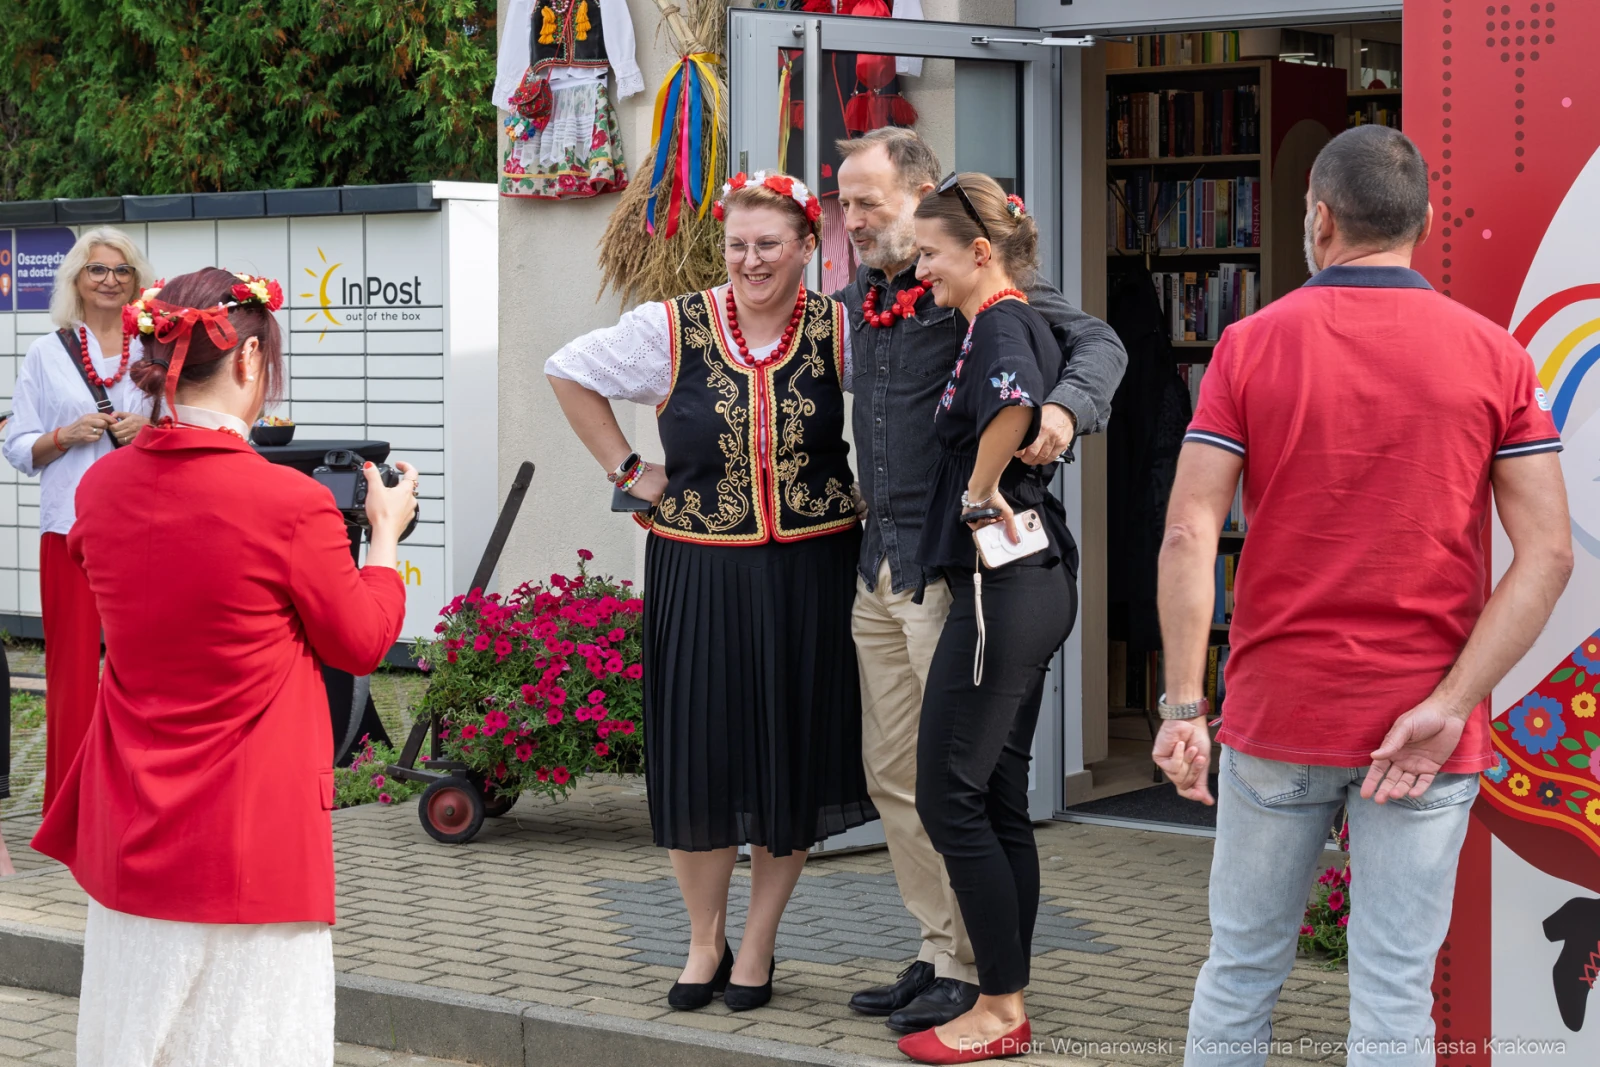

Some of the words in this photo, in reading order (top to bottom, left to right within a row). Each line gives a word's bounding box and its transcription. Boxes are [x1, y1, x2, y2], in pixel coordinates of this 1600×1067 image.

[17, 269, 28, 277] na
[342, 276, 421, 305] InPost
[345, 313, 362, 321] out
[367, 312, 377, 321] of
[381, 312, 398, 321] the
[401, 312, 421, 321] box
